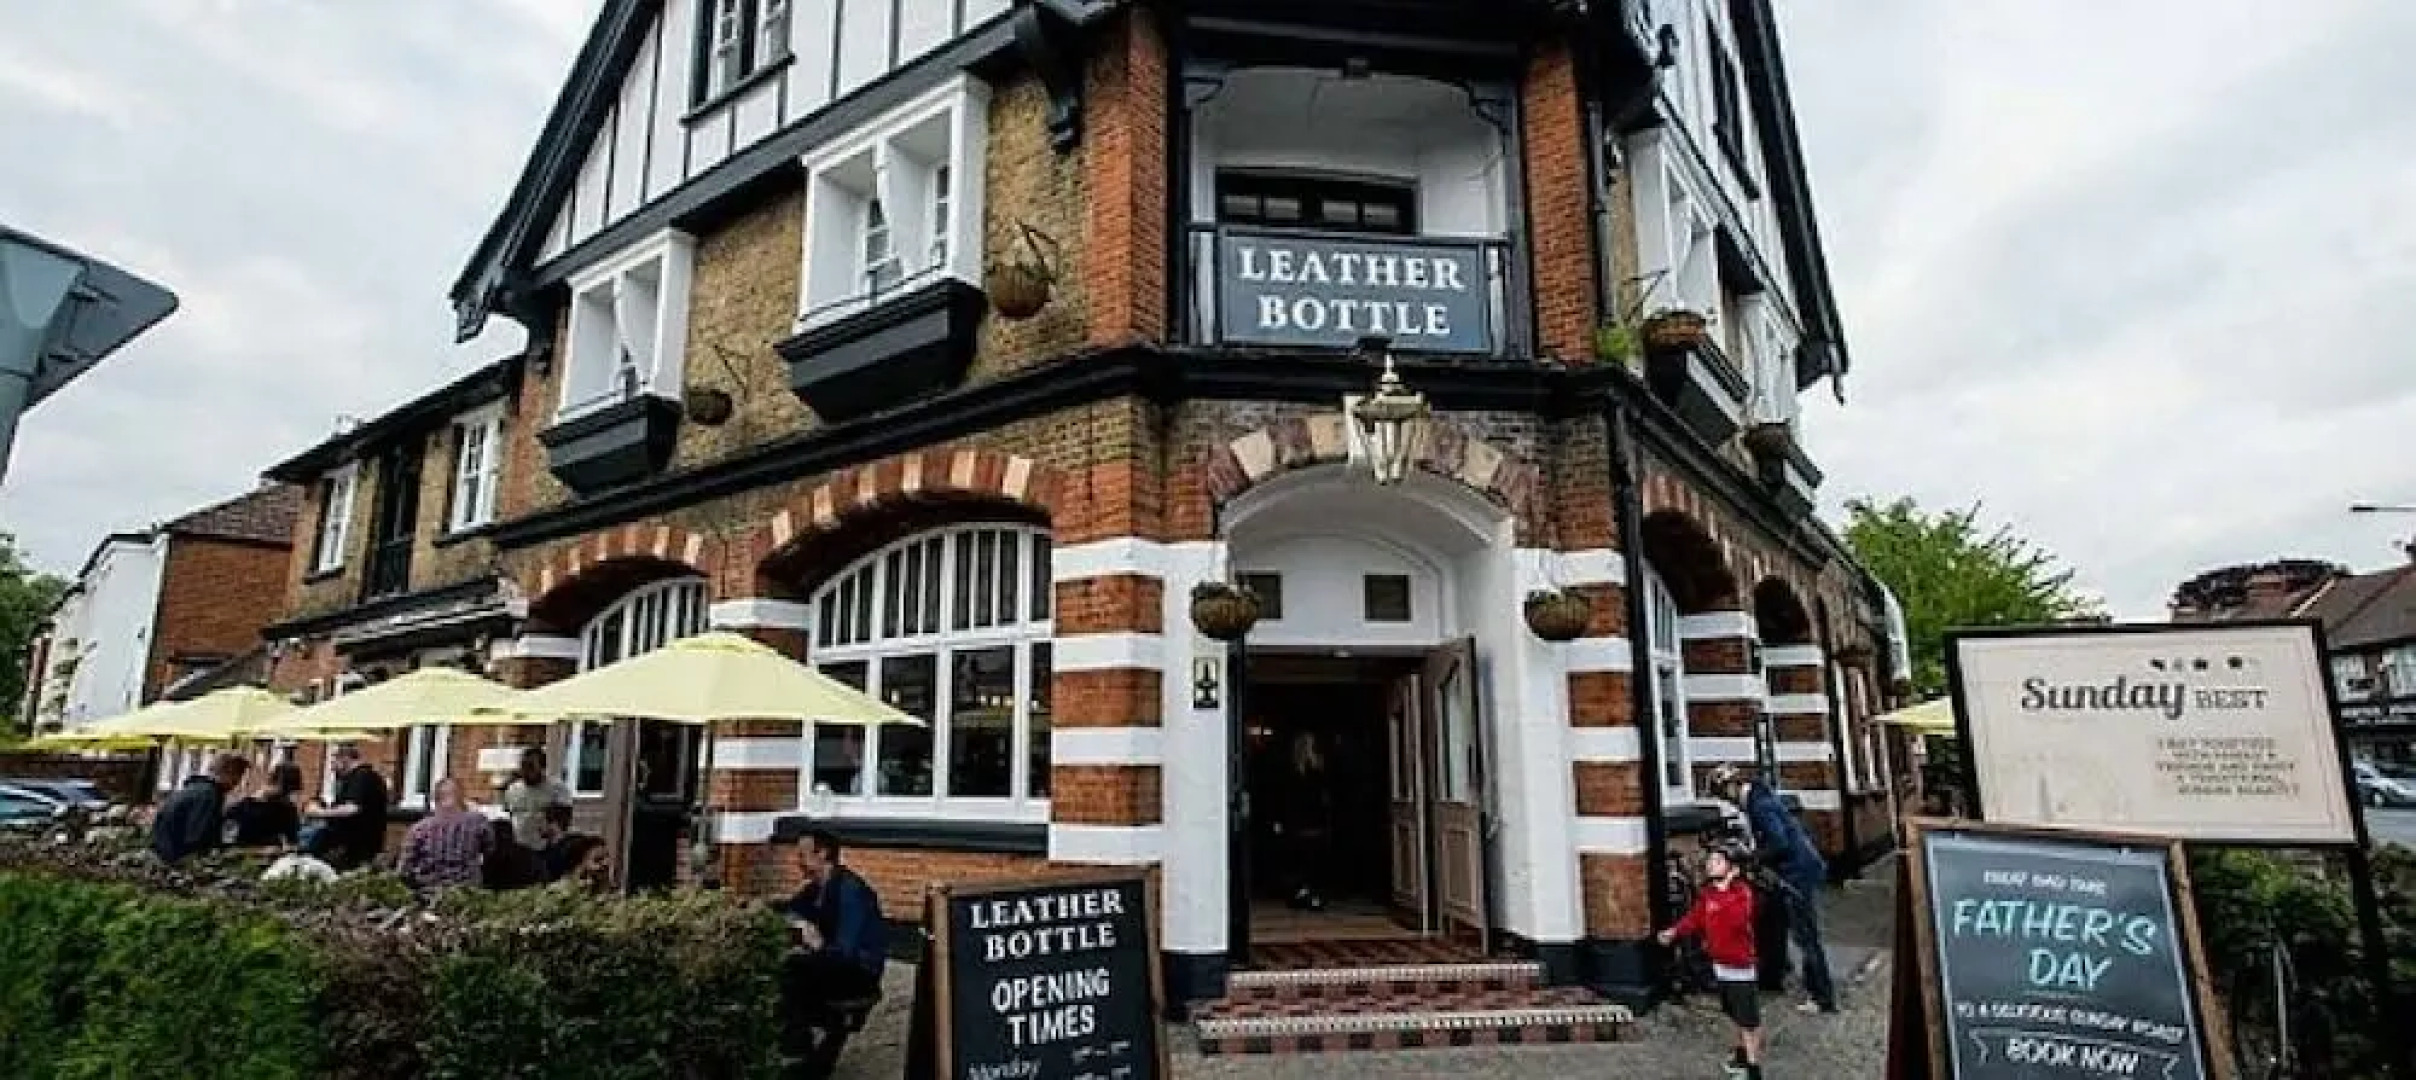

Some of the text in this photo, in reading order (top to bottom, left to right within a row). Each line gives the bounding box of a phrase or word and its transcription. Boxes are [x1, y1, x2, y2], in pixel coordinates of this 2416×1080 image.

[1238, 248, 1465, 291] LEATHER
[1257, 294, 1450, 335] BOTTLE
[2021, 674, 2268, 720] Sunday BEST
[970, 888, 1125, 929] LEATHER
[1952, 898, 2157, 955] FATHER'S
[985, 922, 1116, 962] BOTTLE
[2028, 947, 2112, 989] DAY
[991, 967, 1110, 1013] OPENING
[1007, 1004, 1095, 1047] TIMES
[2007, 1037, 2140, 1074] BOOK NOW
